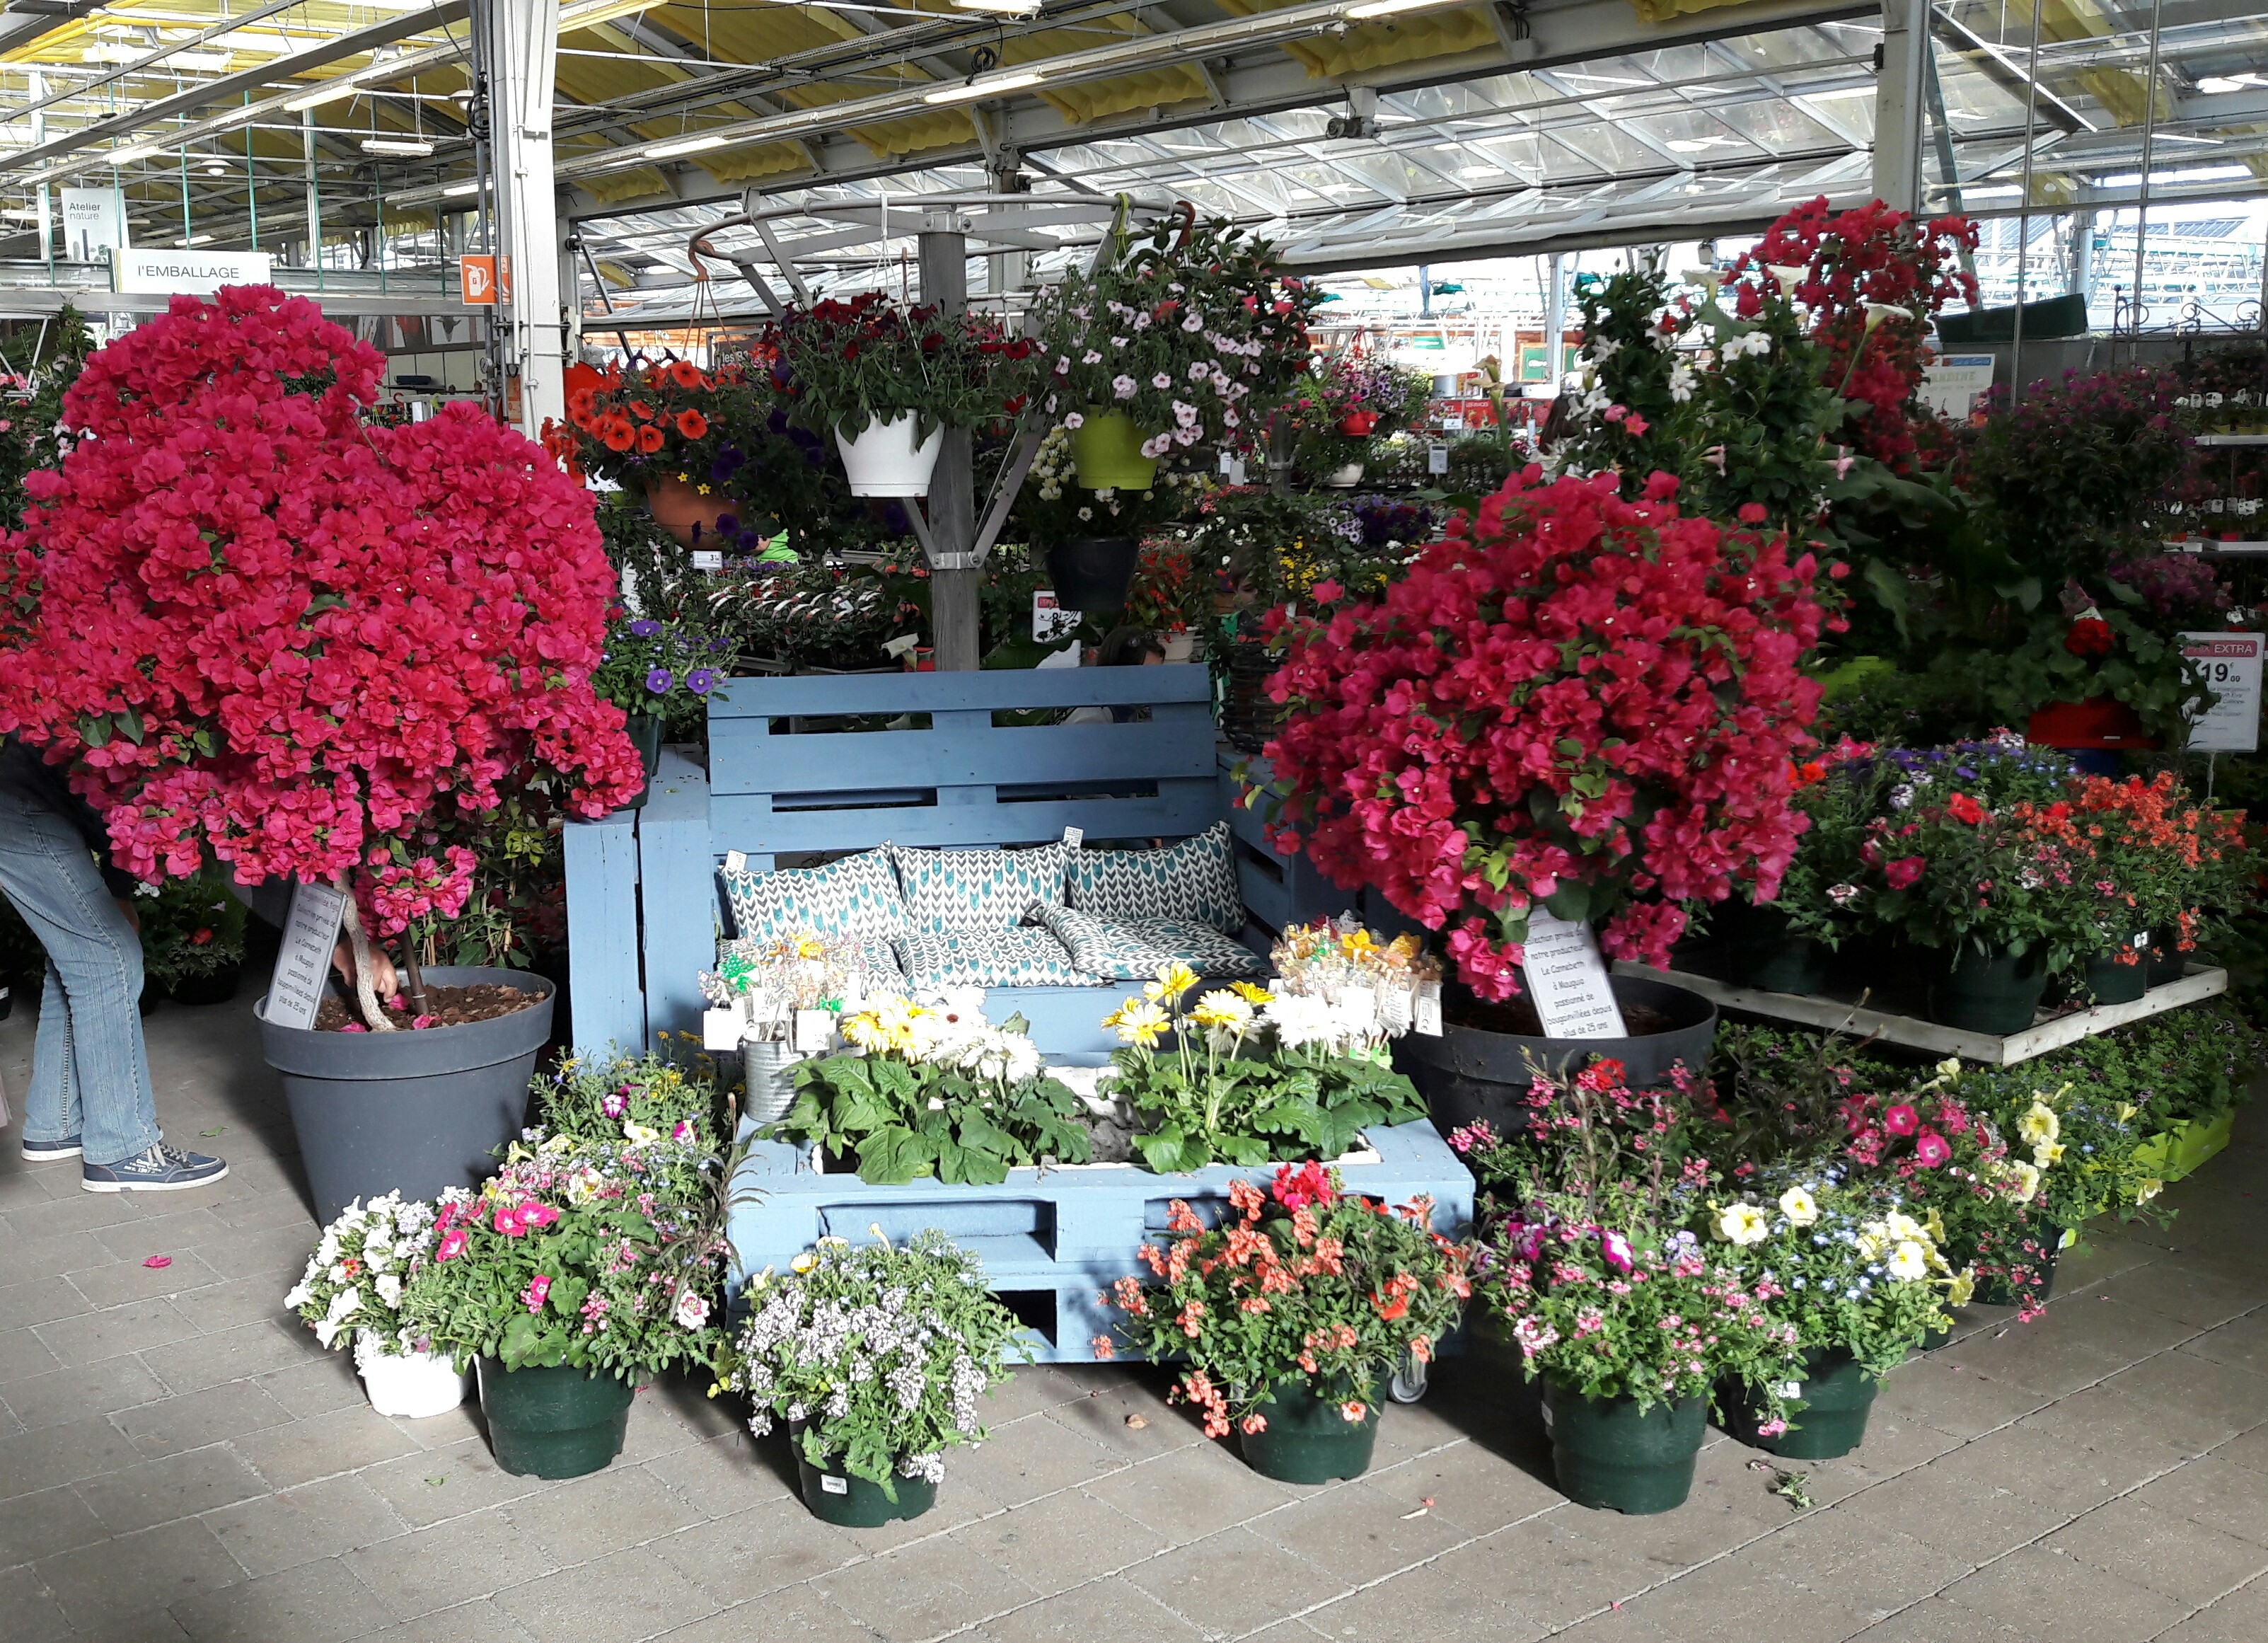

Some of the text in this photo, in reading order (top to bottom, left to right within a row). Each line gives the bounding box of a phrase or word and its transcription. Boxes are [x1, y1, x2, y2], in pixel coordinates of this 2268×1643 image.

[69, 202, 101, 212] Atelier
[69, 212, 100, 220] nature
[138, 265, 240, 279] l'EMBALLAGE
[722, 351, 735, 363] les
[2214, 644, 2253, 654] EXTRA
[2201, 662, 2228, 682] 19
